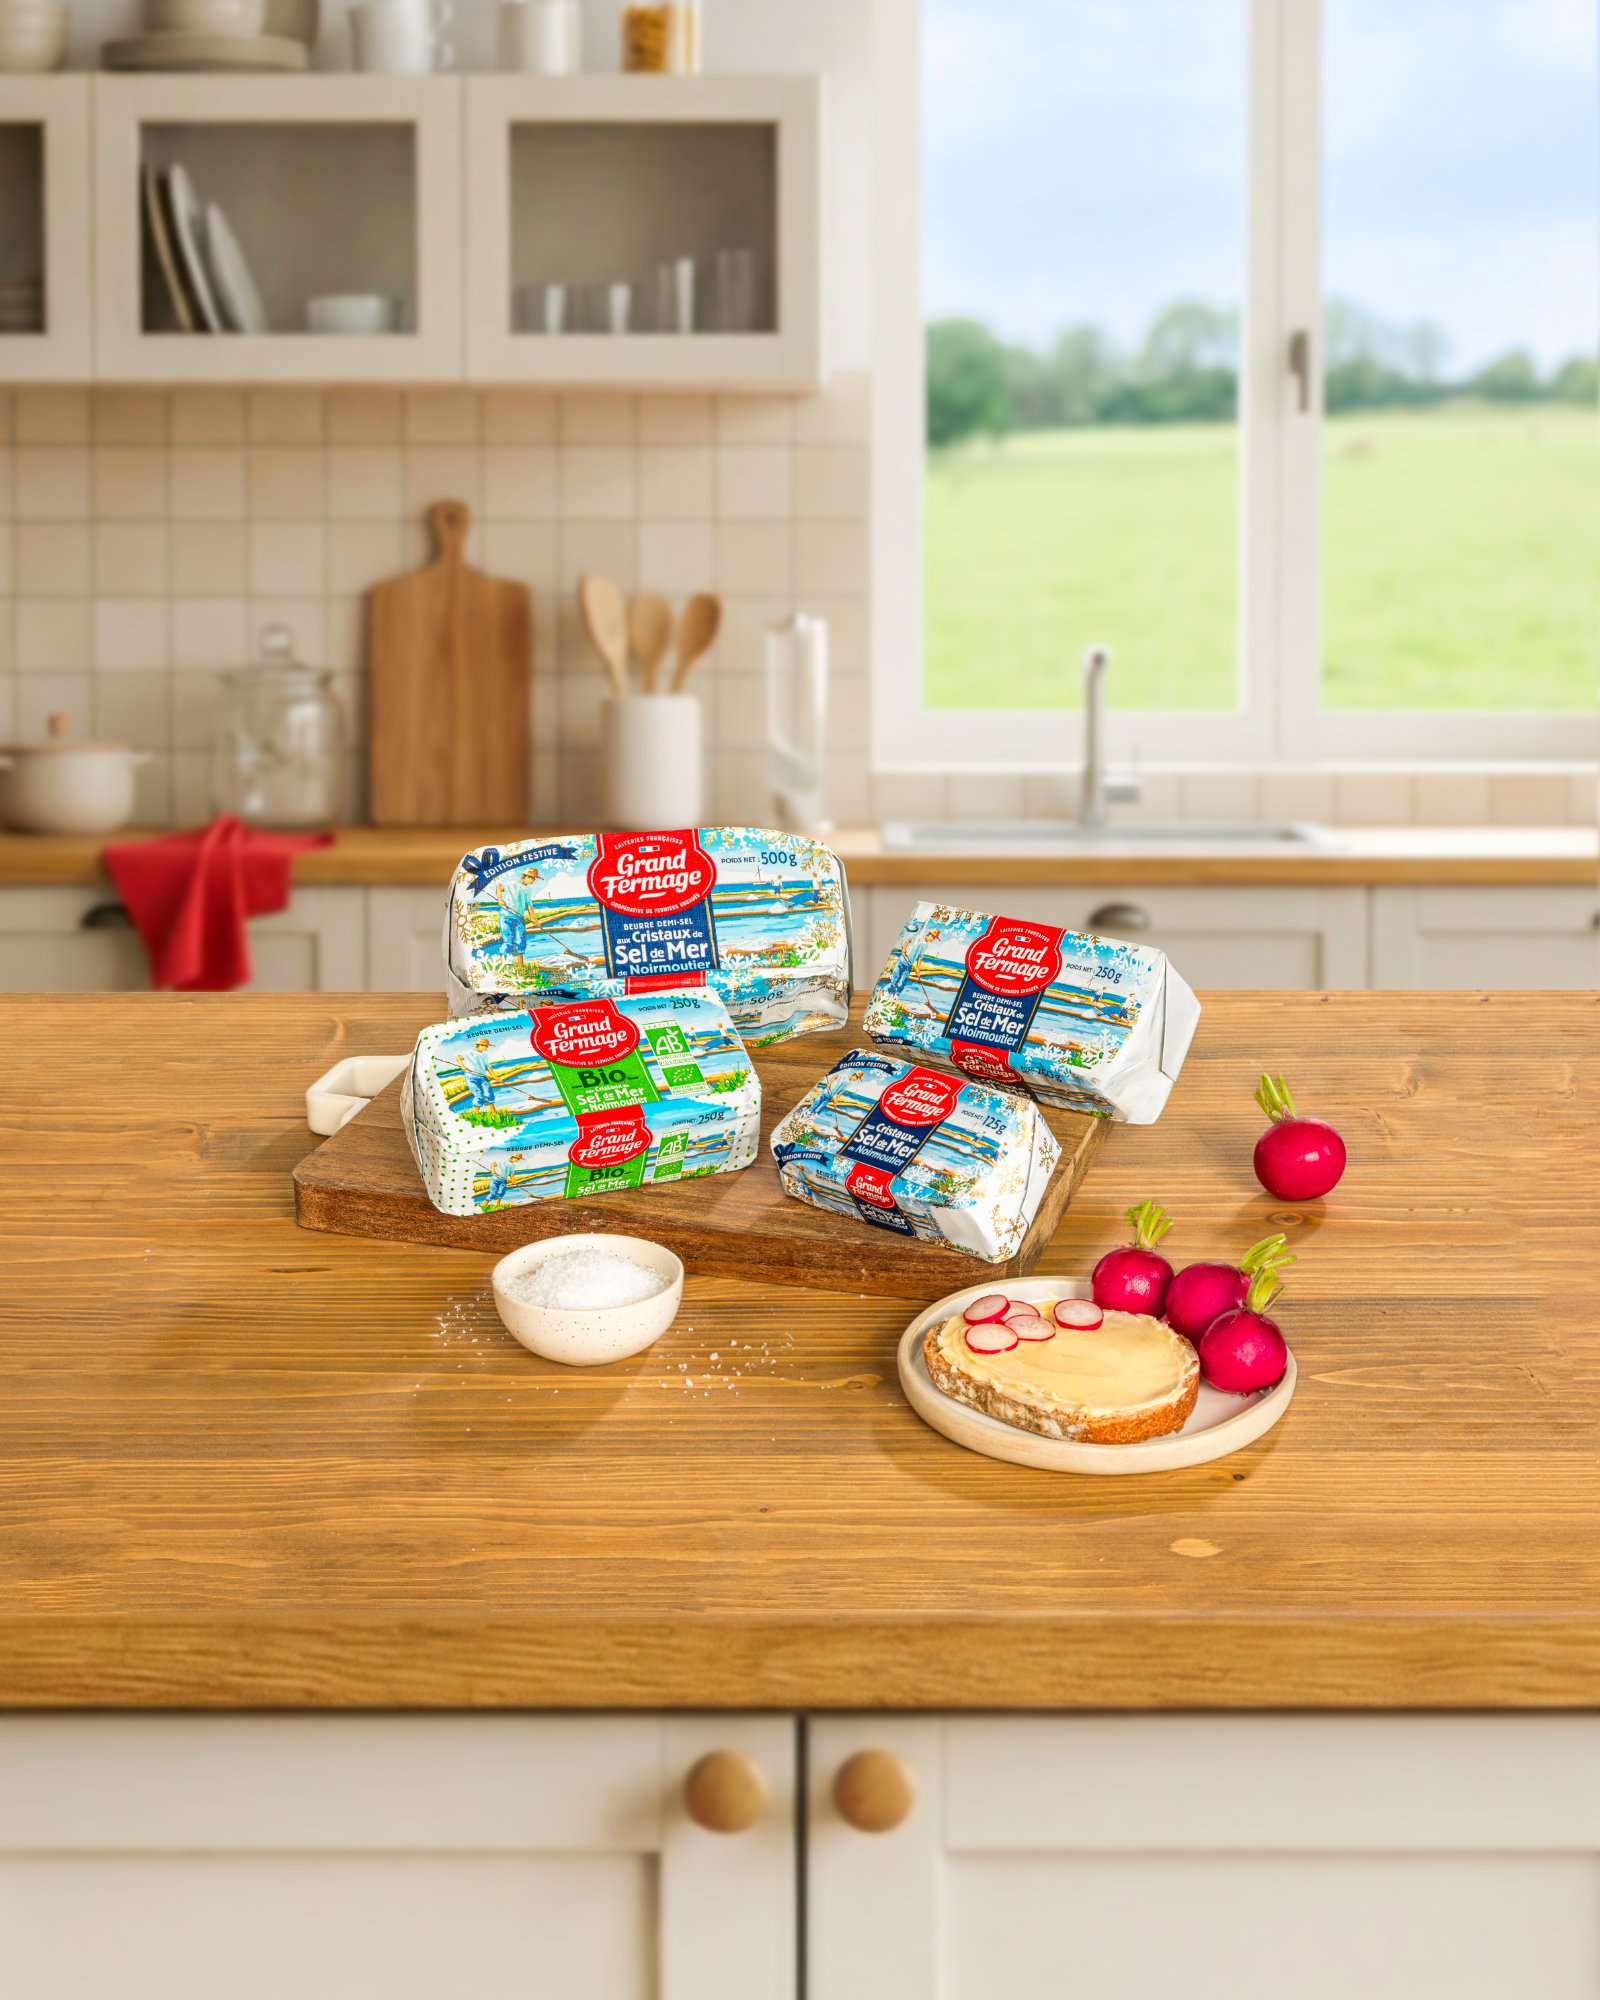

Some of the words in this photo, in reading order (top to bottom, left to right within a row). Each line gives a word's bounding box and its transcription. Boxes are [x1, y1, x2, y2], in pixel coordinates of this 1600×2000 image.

[614, 837, 644, 850] LAITERIES
[646, 835, 683, 845] FRANÇAISES
[483, 857, 520, 879] ÉDITION
[522, 847, 558, 862] FESTIVE
[617, 849, 687, 877] Grand
[600, 870, 702, 899] Fermage
[623, 921, 655, 931] BEURRE
[656, 917, 693, 928] DEMI-SEL
[631, 928, 692, 943] Cristaux
[692, 930, 703, 938] de
[615, 943, 648, 964] Sel
[650, 948, 666, 960] de
[666, 940, 709, 960] Mer
[991, 937, 1049, 963] Grand
[629, 960, 711, 976] Noirmoutier
[974, 951, 1050, 982] Fermage
[1066, 963, 1083, 971] POIDS
[962, 1001, 973, 1009] aux
[974, 999, 1018, 1018] Cristaux
[972, 992, 996, 1002] BEURRE
[996, 997, 1023, 1008] DEMI-SEL
[553, 1015, 612, 1039] Grand
[955, 1007, 982, 1026] Sel
[979, 1016, 993, 1028] de
[991, 1014, 1025, 1035] Mer
[467, 1030, 492, 1039] BEURRE
[493, 1025, 523, 1034] DEMI-SEL
[958, 1024, 1019, 1046] Noirmoutier
[543, 1030, 628, 1056] Fermage
[655, 1034, 683, 1056] AB
[866, 1061, 889, 1070] FESTIVE
[958, 1060, 1016, 1078] Fermage
[964, 1054, 1005, 1072] Grand
[577, 1068, 626, 1089] Bio
[594, 1084, 622, 1093] Cristaux
[576, 1092, 601, 1105] Sel
[602, 1092, 615, 1100] de
[615, 1087, 644, 1099] Mer
[589, 1096, 648, 1112] Noirmoutier
[886, 1091, 945, 1117] Fermage
[903, 1083, 949, 1105] Grand
[589, 1128, 637, 1149] Grand
[875, 1122, 915, 1143] Cristaux
[577, 1140, 643, 1160] Fermage
[660, 1140, 683, 1157] AB
[854, 1128, 881, 1147] Sel
[875, 1140, 888, 1150] de
[885, 1138, 917, 1158] Mer
[802, 1152, 822, 1160] FESTIVE
[855, 1144, 905, 1167] Noirmoutier
[577, 1184, 596, 1194] Sel
[607, 1179, 631, 1188] Mer
[849, 1184, 891, 1203] Fermage
[855, 1176, 884, 1196] Grand
[884, 1212, 906, 1225] Mer
